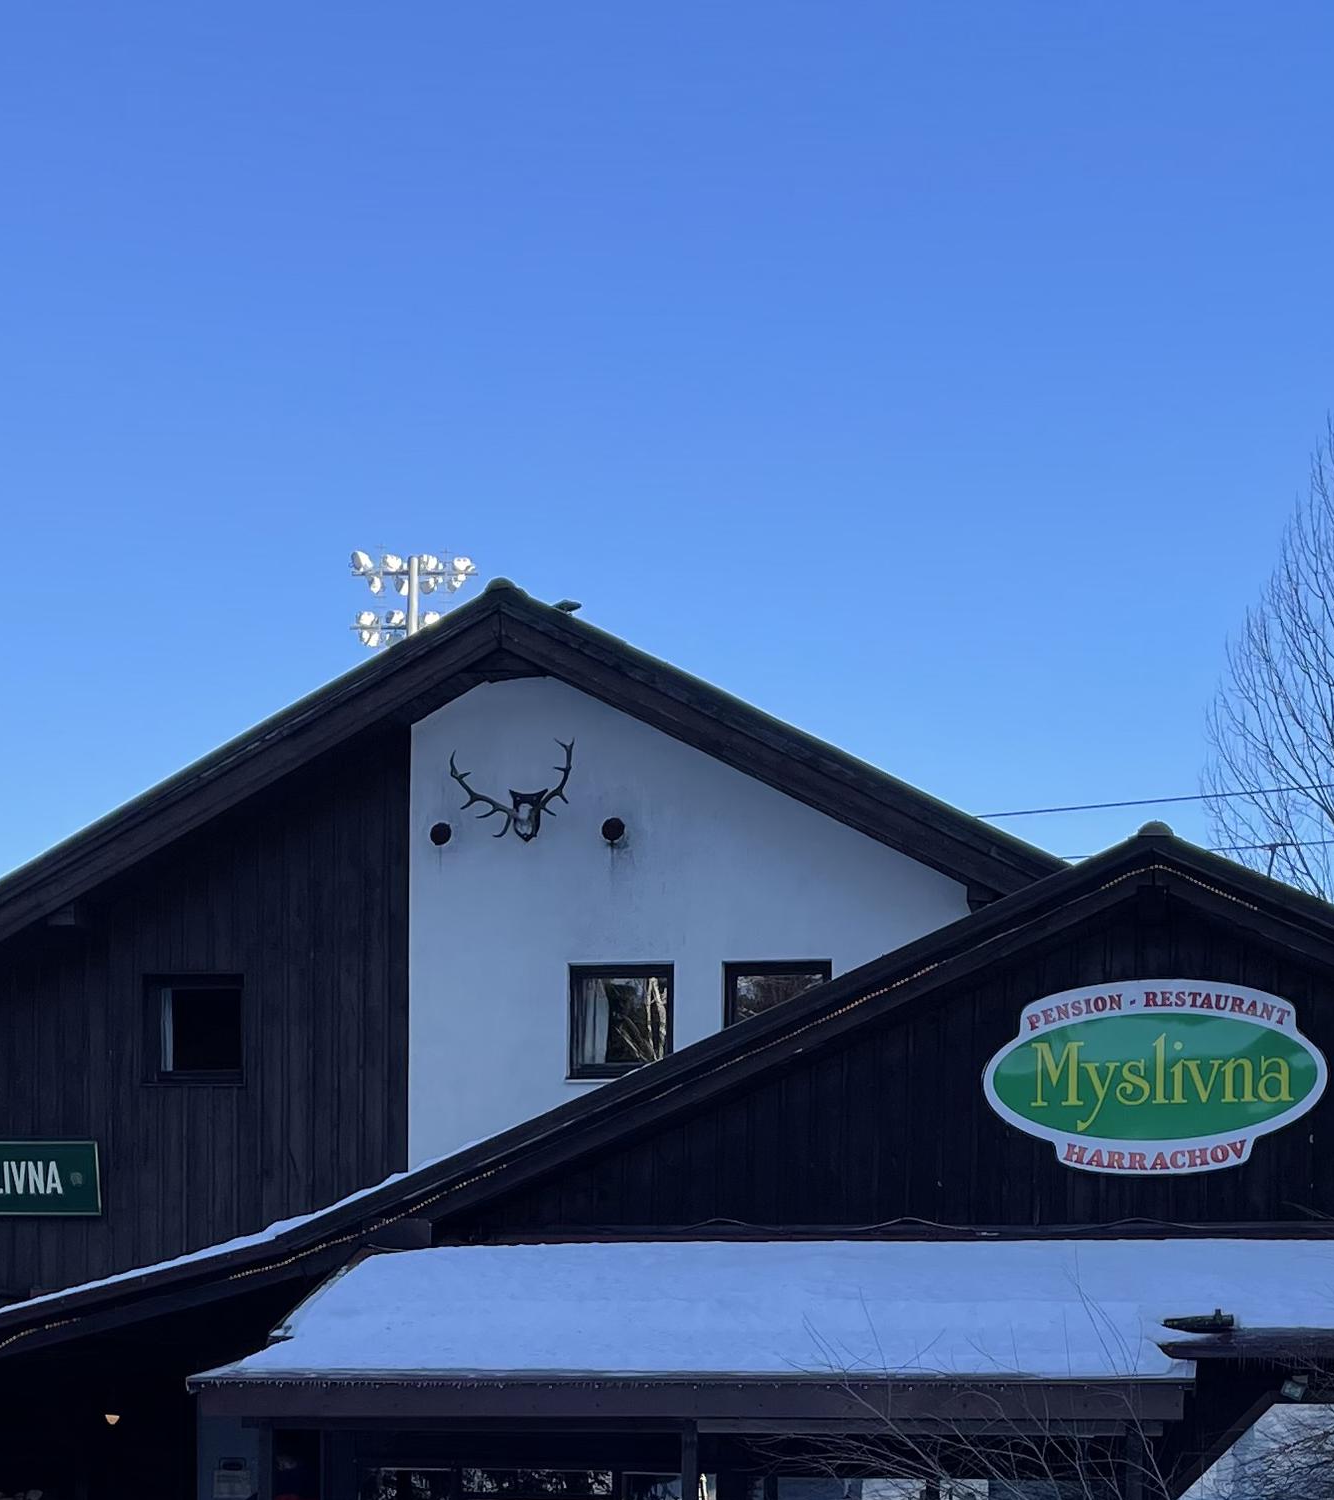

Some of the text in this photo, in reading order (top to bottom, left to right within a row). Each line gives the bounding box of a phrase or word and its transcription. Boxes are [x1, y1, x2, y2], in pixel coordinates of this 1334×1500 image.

[1026, 993, 1123, 1031] PENSION
[1143, 991, 1291, 1026] RESTAURANT
[1030, 1032, 1295, 1132] Myslivna
[1062, 1139, 1248, 1171] HARRACHOV
